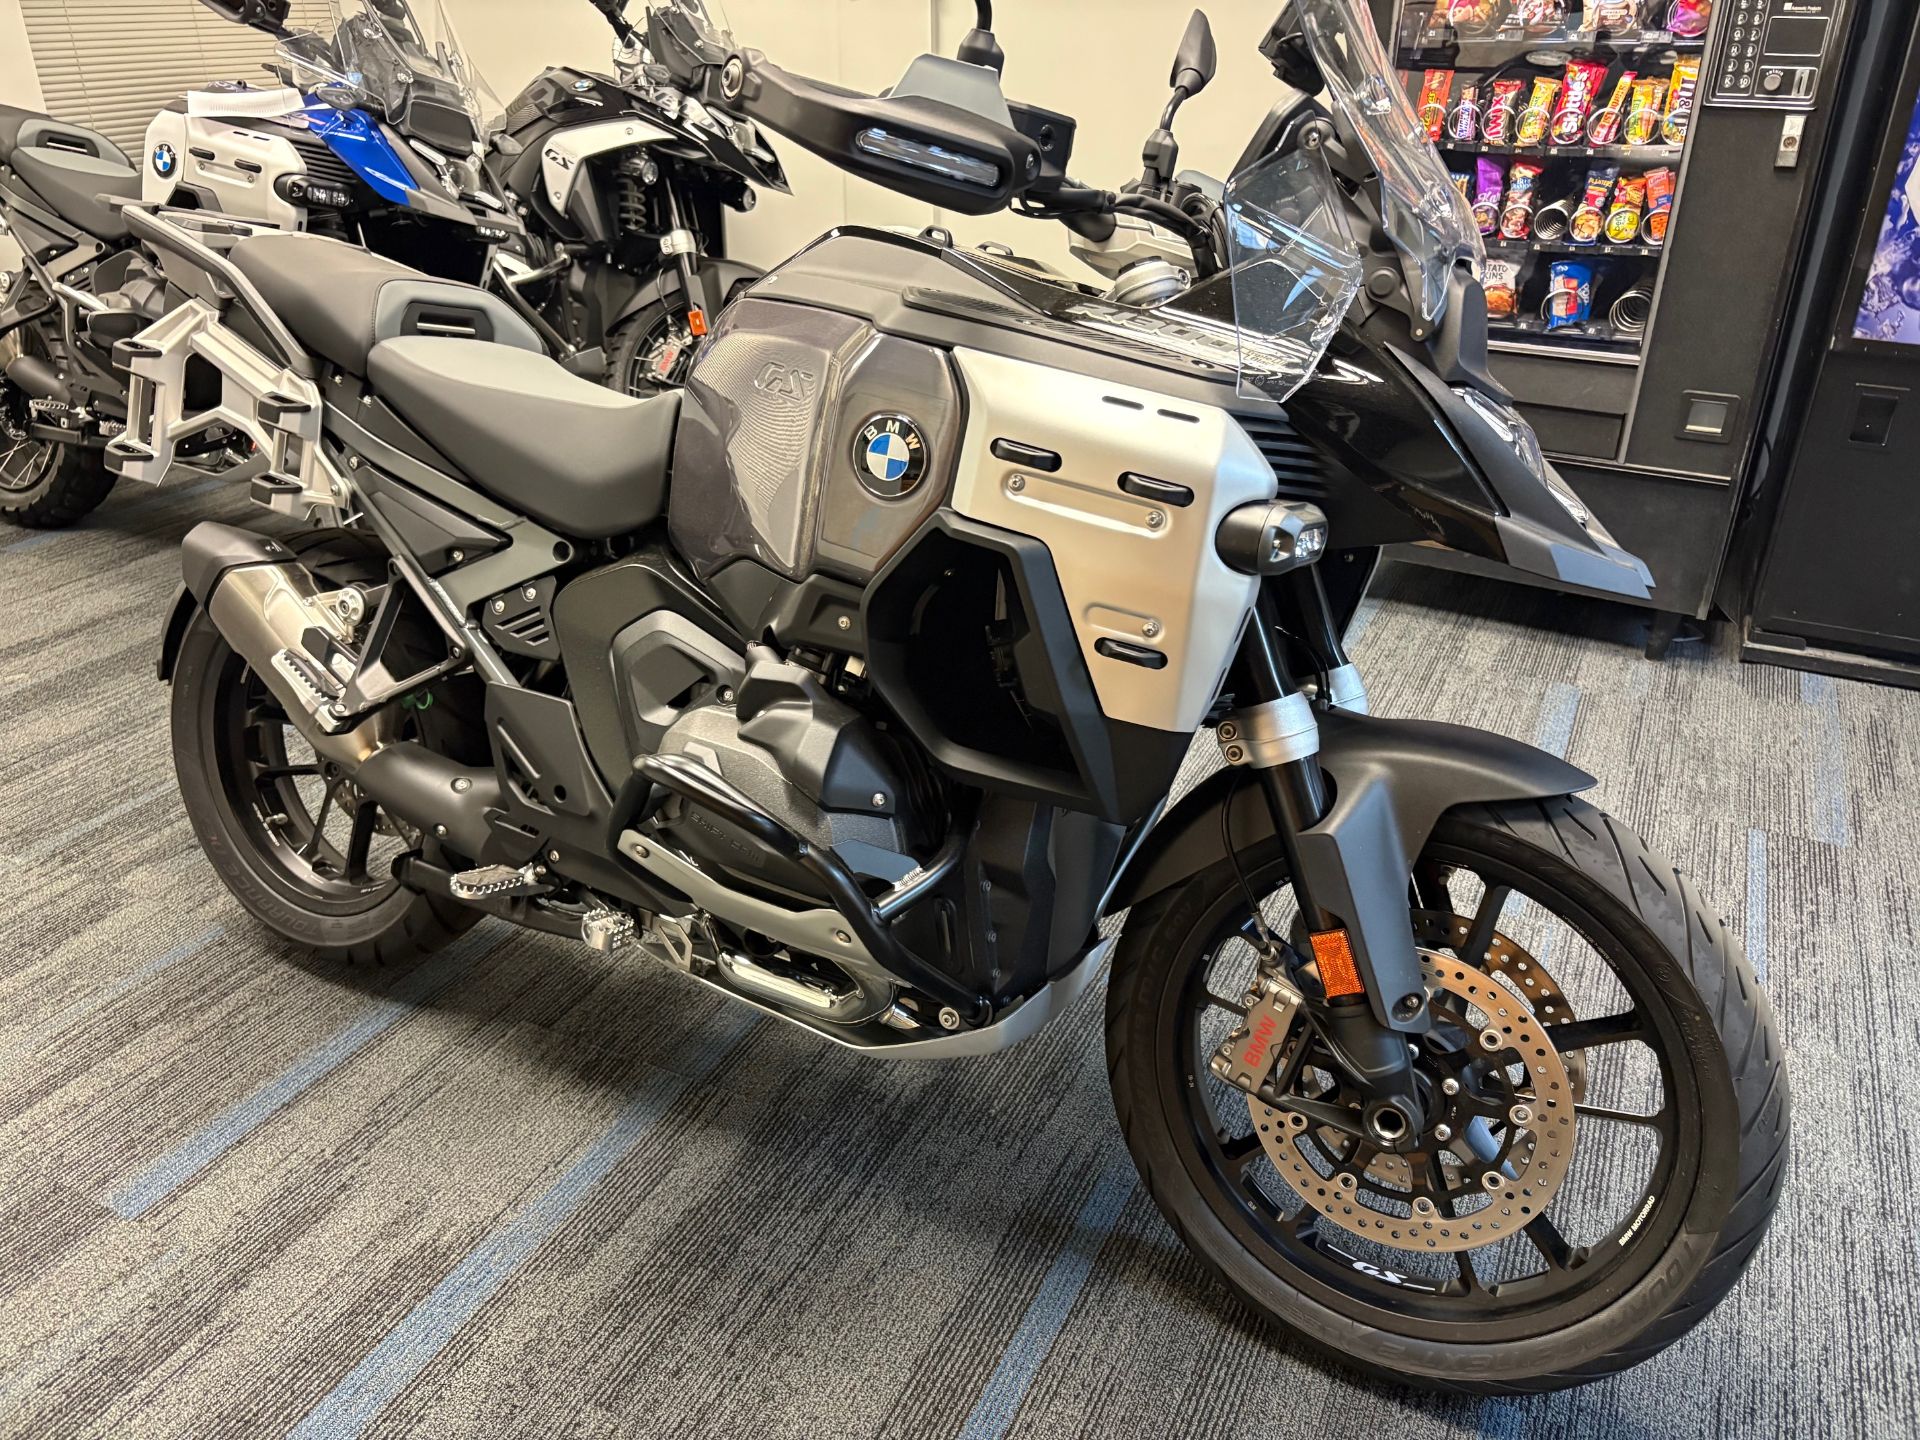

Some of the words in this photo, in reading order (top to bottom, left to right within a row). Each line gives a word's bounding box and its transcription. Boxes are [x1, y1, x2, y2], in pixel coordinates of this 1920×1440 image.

[1561, 69, 1590, 133] Skttles
[1485, 270, 1504, 280] KINS
[1487, 263, 1509, 273] TATO
[1243, 1014, 1278, 1068] BMW
[1618, 1228, 1634, 1247] BMW
[1630, 1194, 1656, 1232] MOTORRAD
[1352, 1260, 1409, 1285] GS
